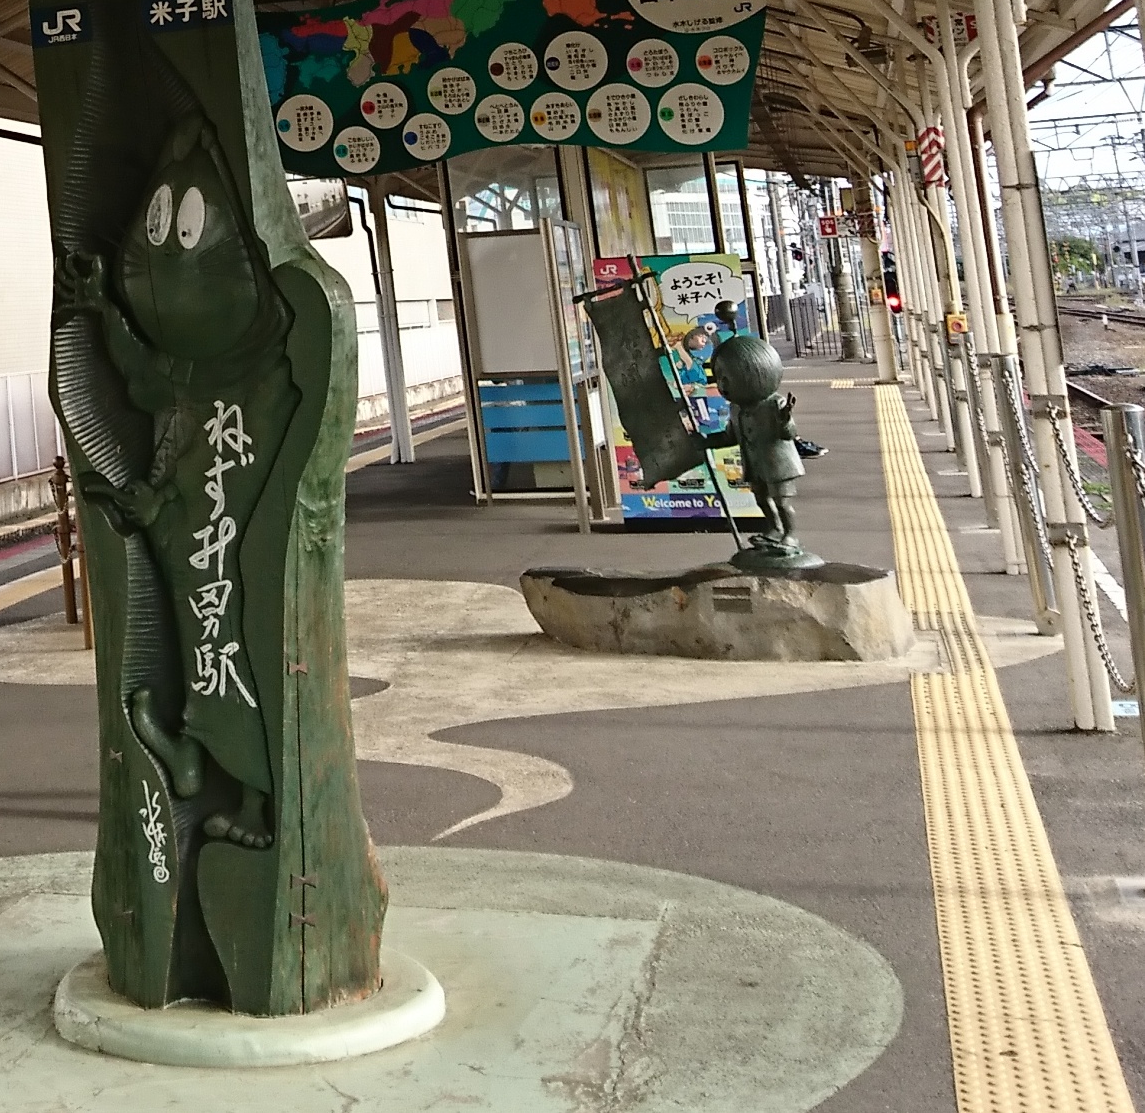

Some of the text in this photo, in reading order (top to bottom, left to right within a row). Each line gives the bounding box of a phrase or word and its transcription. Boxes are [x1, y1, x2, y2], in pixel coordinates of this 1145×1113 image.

[734, 2, 752, 13] JR
[42, 8, 82, 36] JR
[600, 264, 618, 275] JR
[641, 496, 692, 508] Welcome
[693, 499, 704, 508] to
